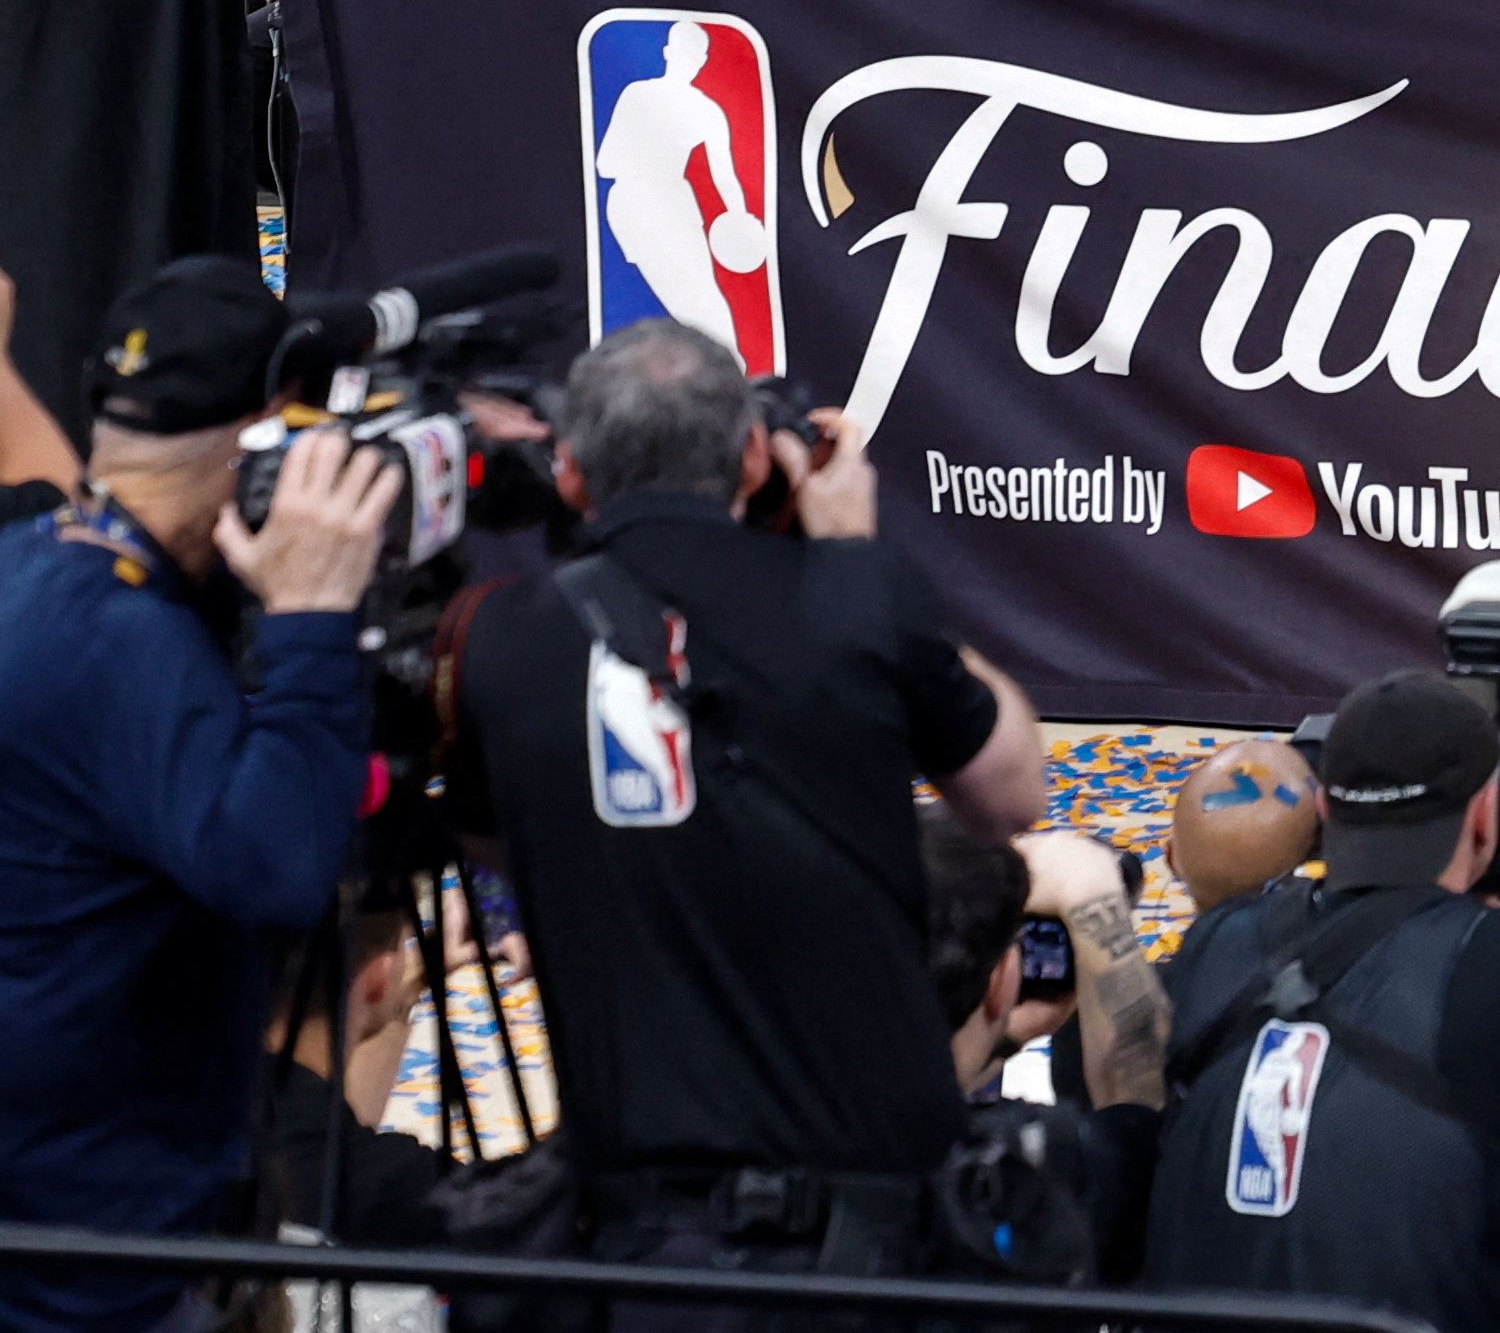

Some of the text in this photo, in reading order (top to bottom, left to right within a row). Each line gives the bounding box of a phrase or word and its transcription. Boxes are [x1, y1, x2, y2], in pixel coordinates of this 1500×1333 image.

[928, 448, 1107, 525] Presented
[1122, 461, 1166, 537] by
[1238, 1165, 1274, 1203] NBA
